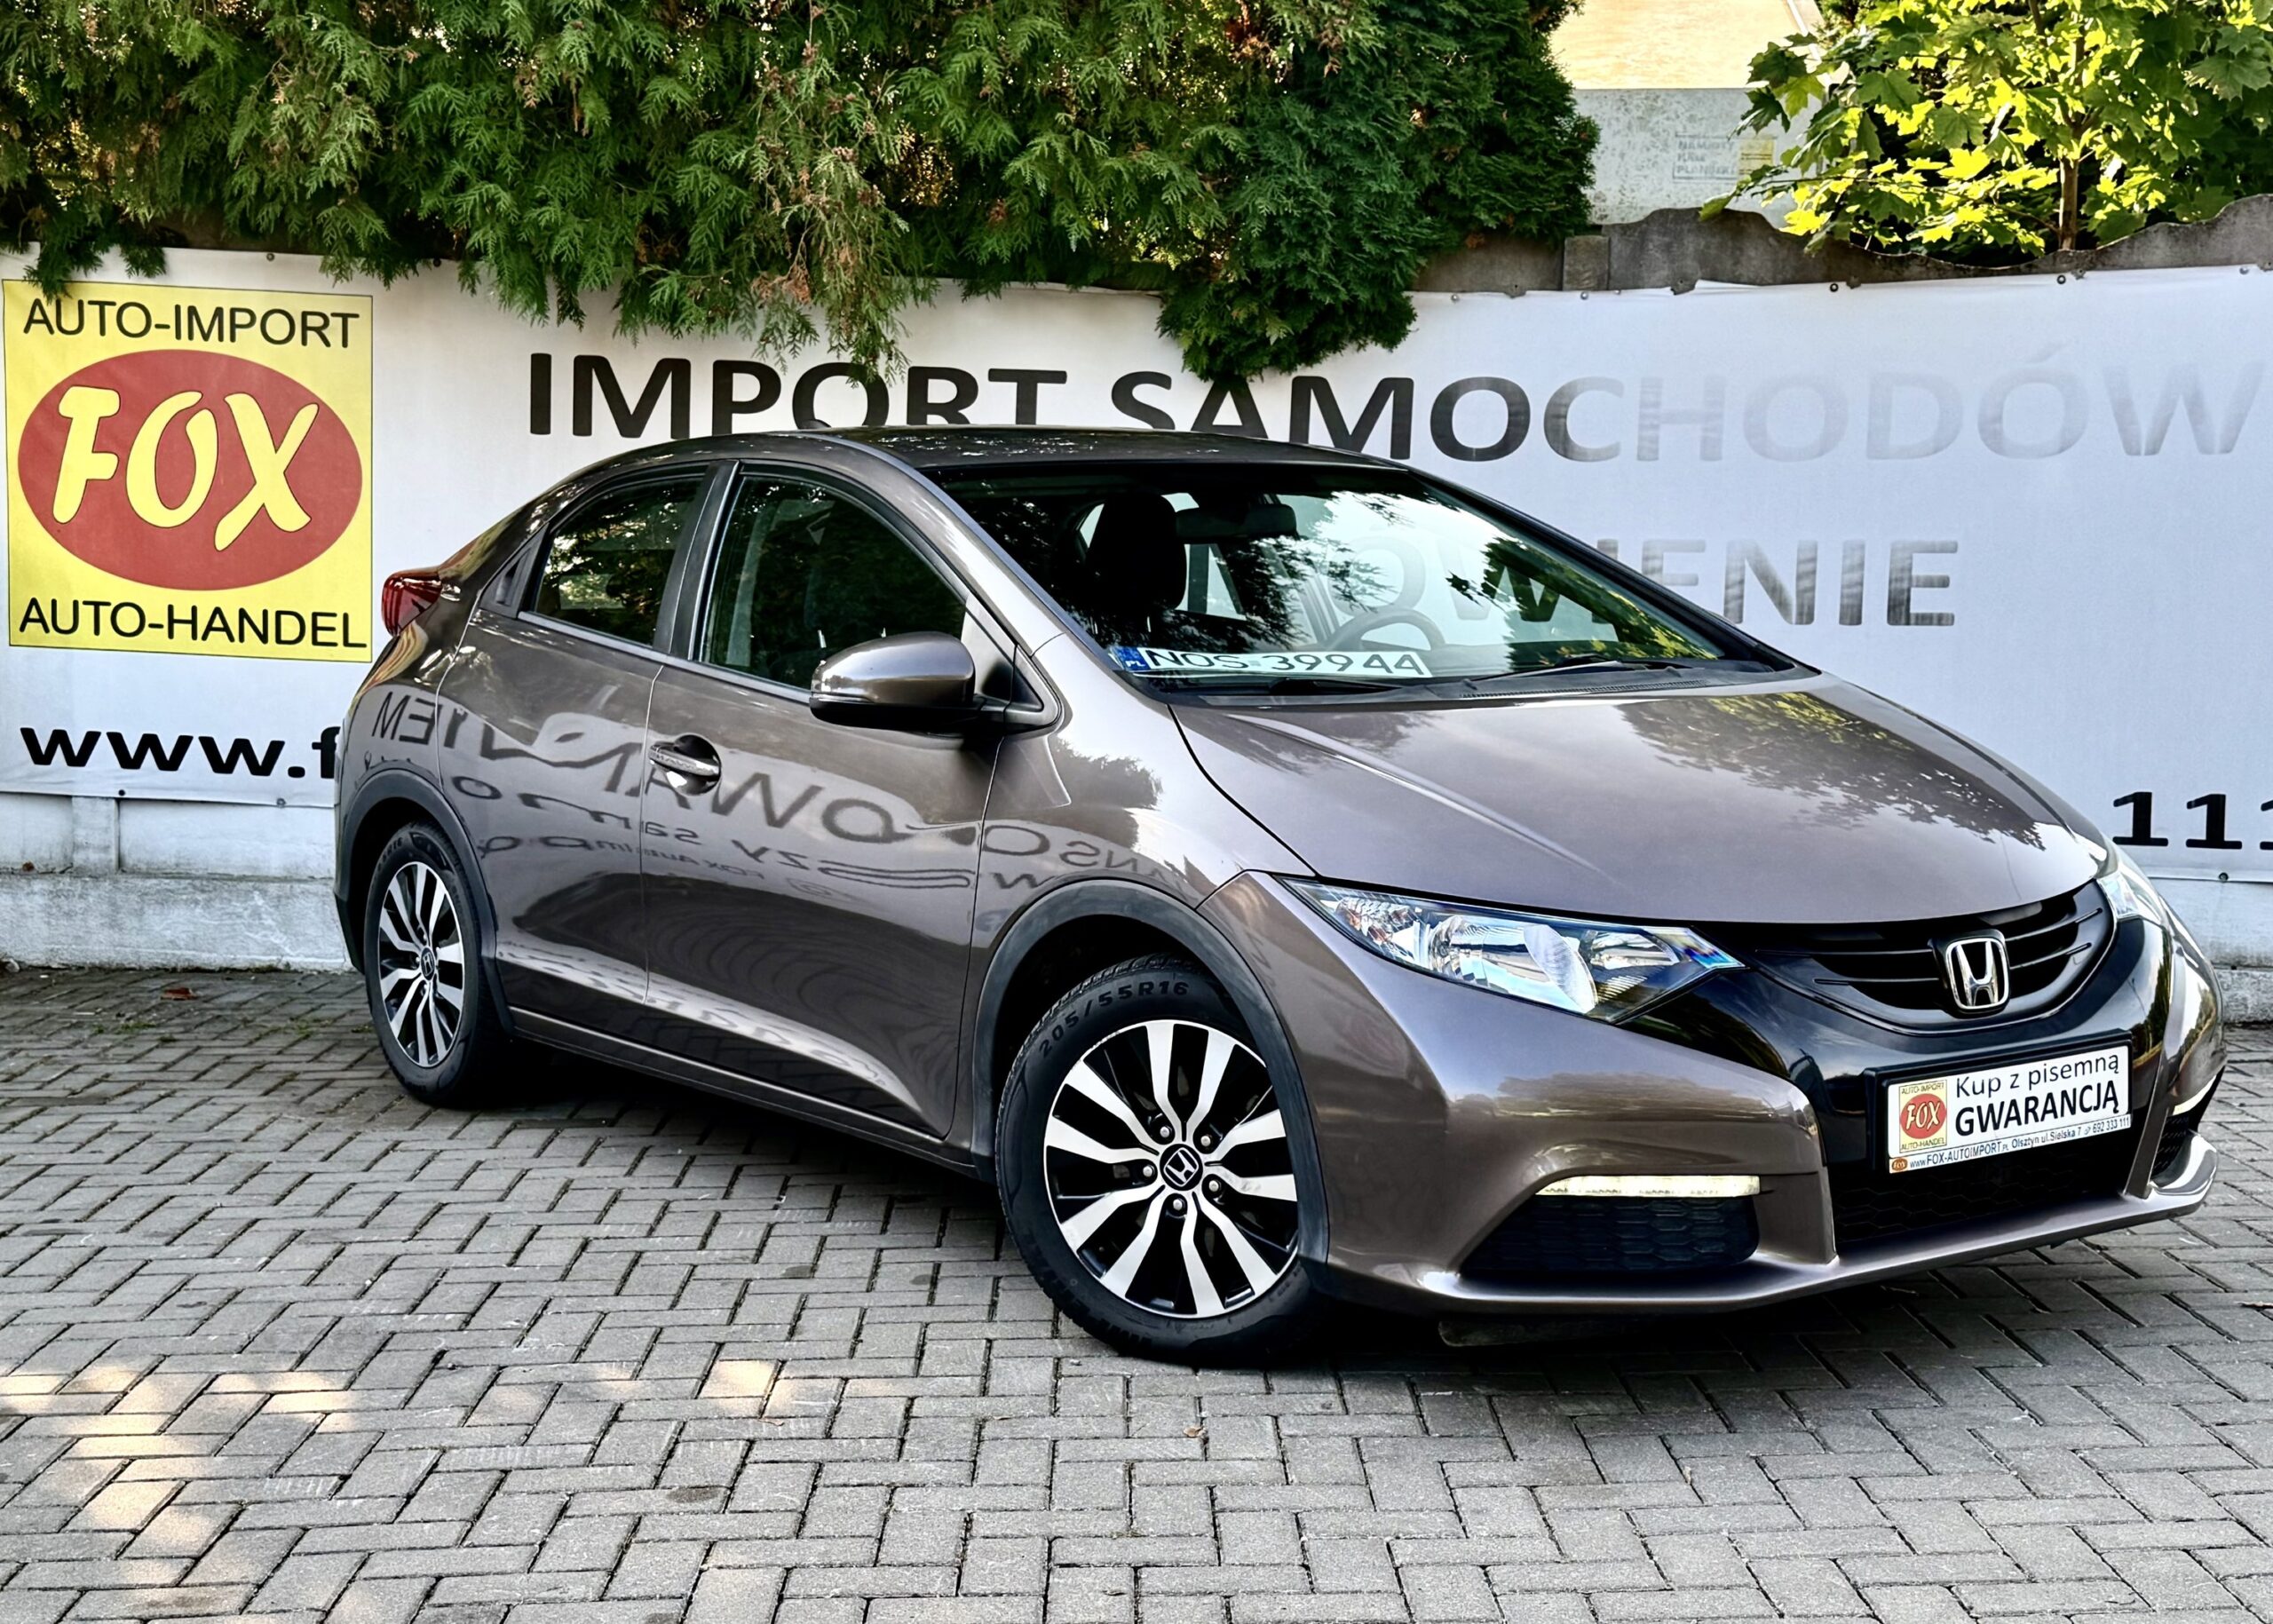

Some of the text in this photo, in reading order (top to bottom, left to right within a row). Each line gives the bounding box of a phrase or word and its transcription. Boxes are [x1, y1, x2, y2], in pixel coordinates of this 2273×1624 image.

[23, 297, 360, 349] AUTO-IMPORT
[530, 343, 2264, 462] IMPORT SAMOCHODÓW
[52, 385, 320, 552] FOX
[19, 597, 368, 649] AUTO-HANDEL
[1145, 649, 1249, 669] NOS
[2112, 790, 2273, 851] 11
[1039, 980, 1190, 1058] 205/55R16
[1901, 1081, 1944, 1095] AUTO-IMPORT
[1956, 1054, 2119, 1098] Kup z pisemną
[1905, 1100, 1942, 1132] FOX
[1955, 1080, 2119, 1137] GWARANCJĄ
[2011, 1137, 2039, 1148] Olsztyn
[2092, 1121, 2104, 1134] 692
[2106, 1118, 2118, 1130] 333
[1900, 1137, 1944, 1151] AUTO-HANDEL
